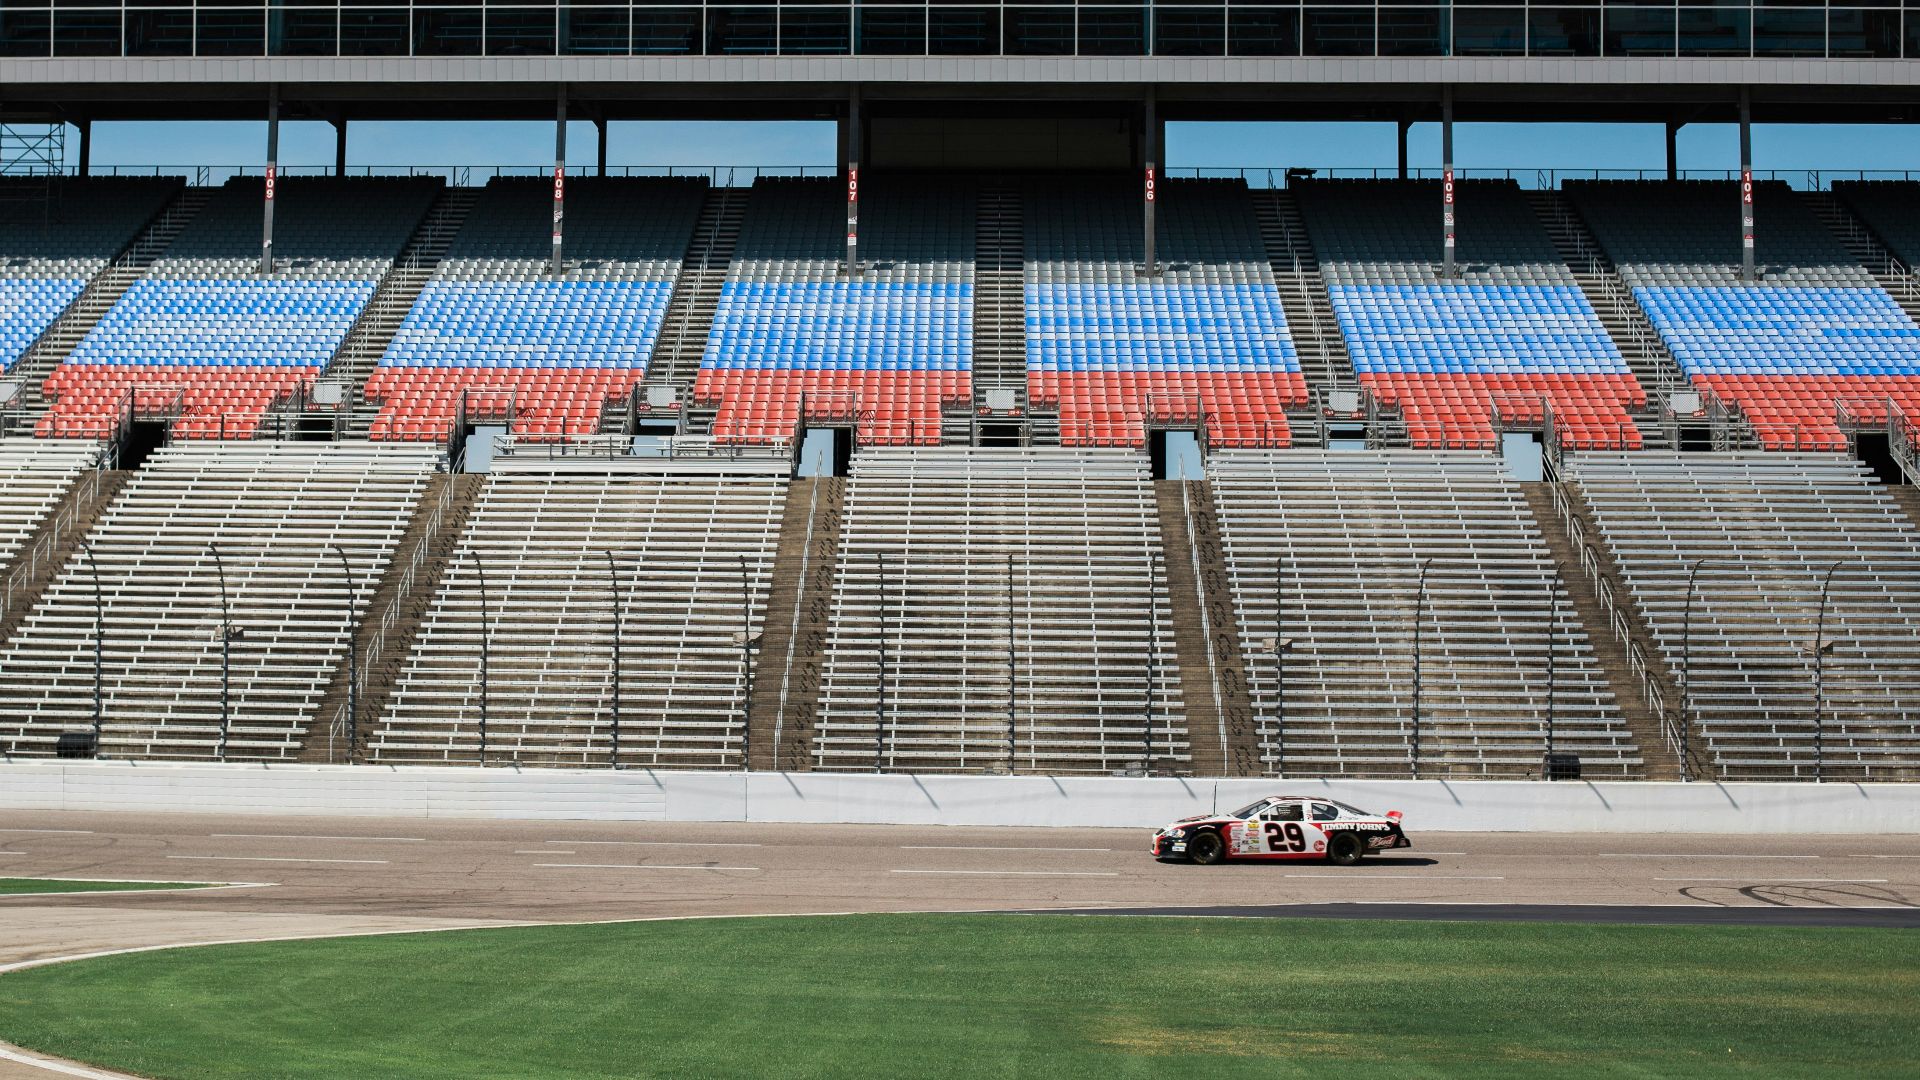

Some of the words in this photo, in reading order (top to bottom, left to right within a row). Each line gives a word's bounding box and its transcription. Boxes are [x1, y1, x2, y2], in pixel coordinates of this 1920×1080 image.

[555, 168, 563, 199] 108
[849, 170, 857, 200] 107
[1744, 172, 1752, 203] 104
[1264, 822, 1307, 852] 29
[1321, 823, 1356, 832] JIMMY
[1356, 823, 1391, 832] JOHN'S
[1368, 836, 1394, 847] Bud
